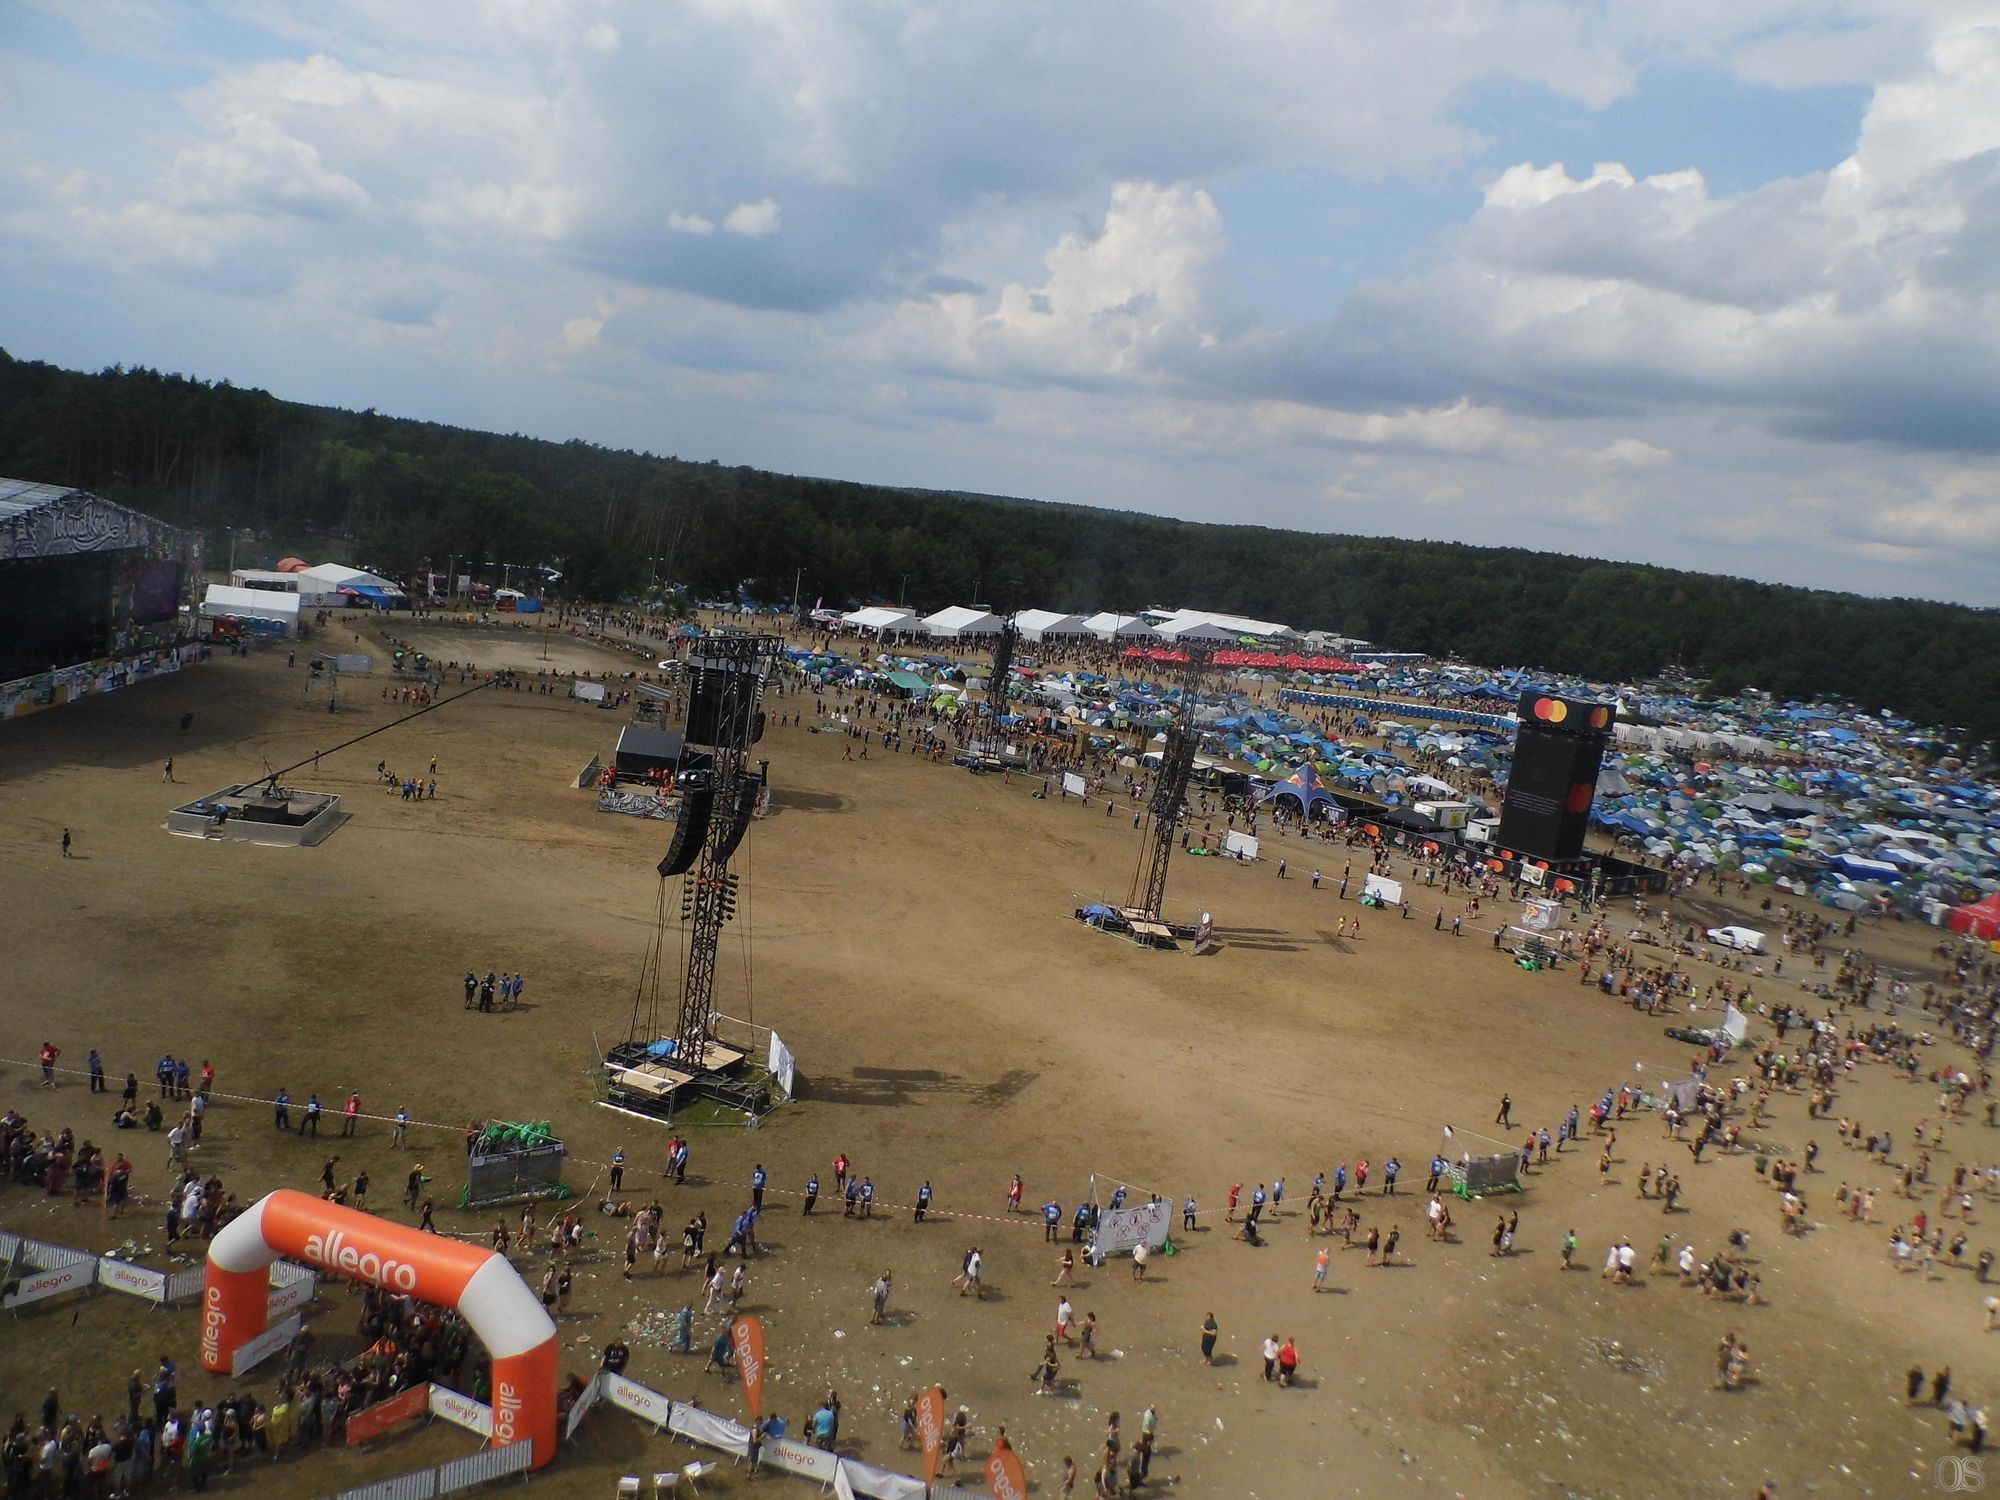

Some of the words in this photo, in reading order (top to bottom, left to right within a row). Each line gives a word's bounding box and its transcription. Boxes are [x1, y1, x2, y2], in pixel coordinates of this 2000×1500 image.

[115, 1270, 149, 1287] allegro
[304, 1230, 416, 1290] allegro
[27, 1273, 72, 1293] allegro
[202, 1286, 226, 1365] allegro
[737, 1324, 760, 1387] allegro
[445, 1399, 478, 1420] allegro
[495, 1382, 522, 1445] allegr
[617, 1386, 651, 1409] allegro
[920, 1396, 939, 1452] allegro
[773, 1444, 815, 1466] allegro
